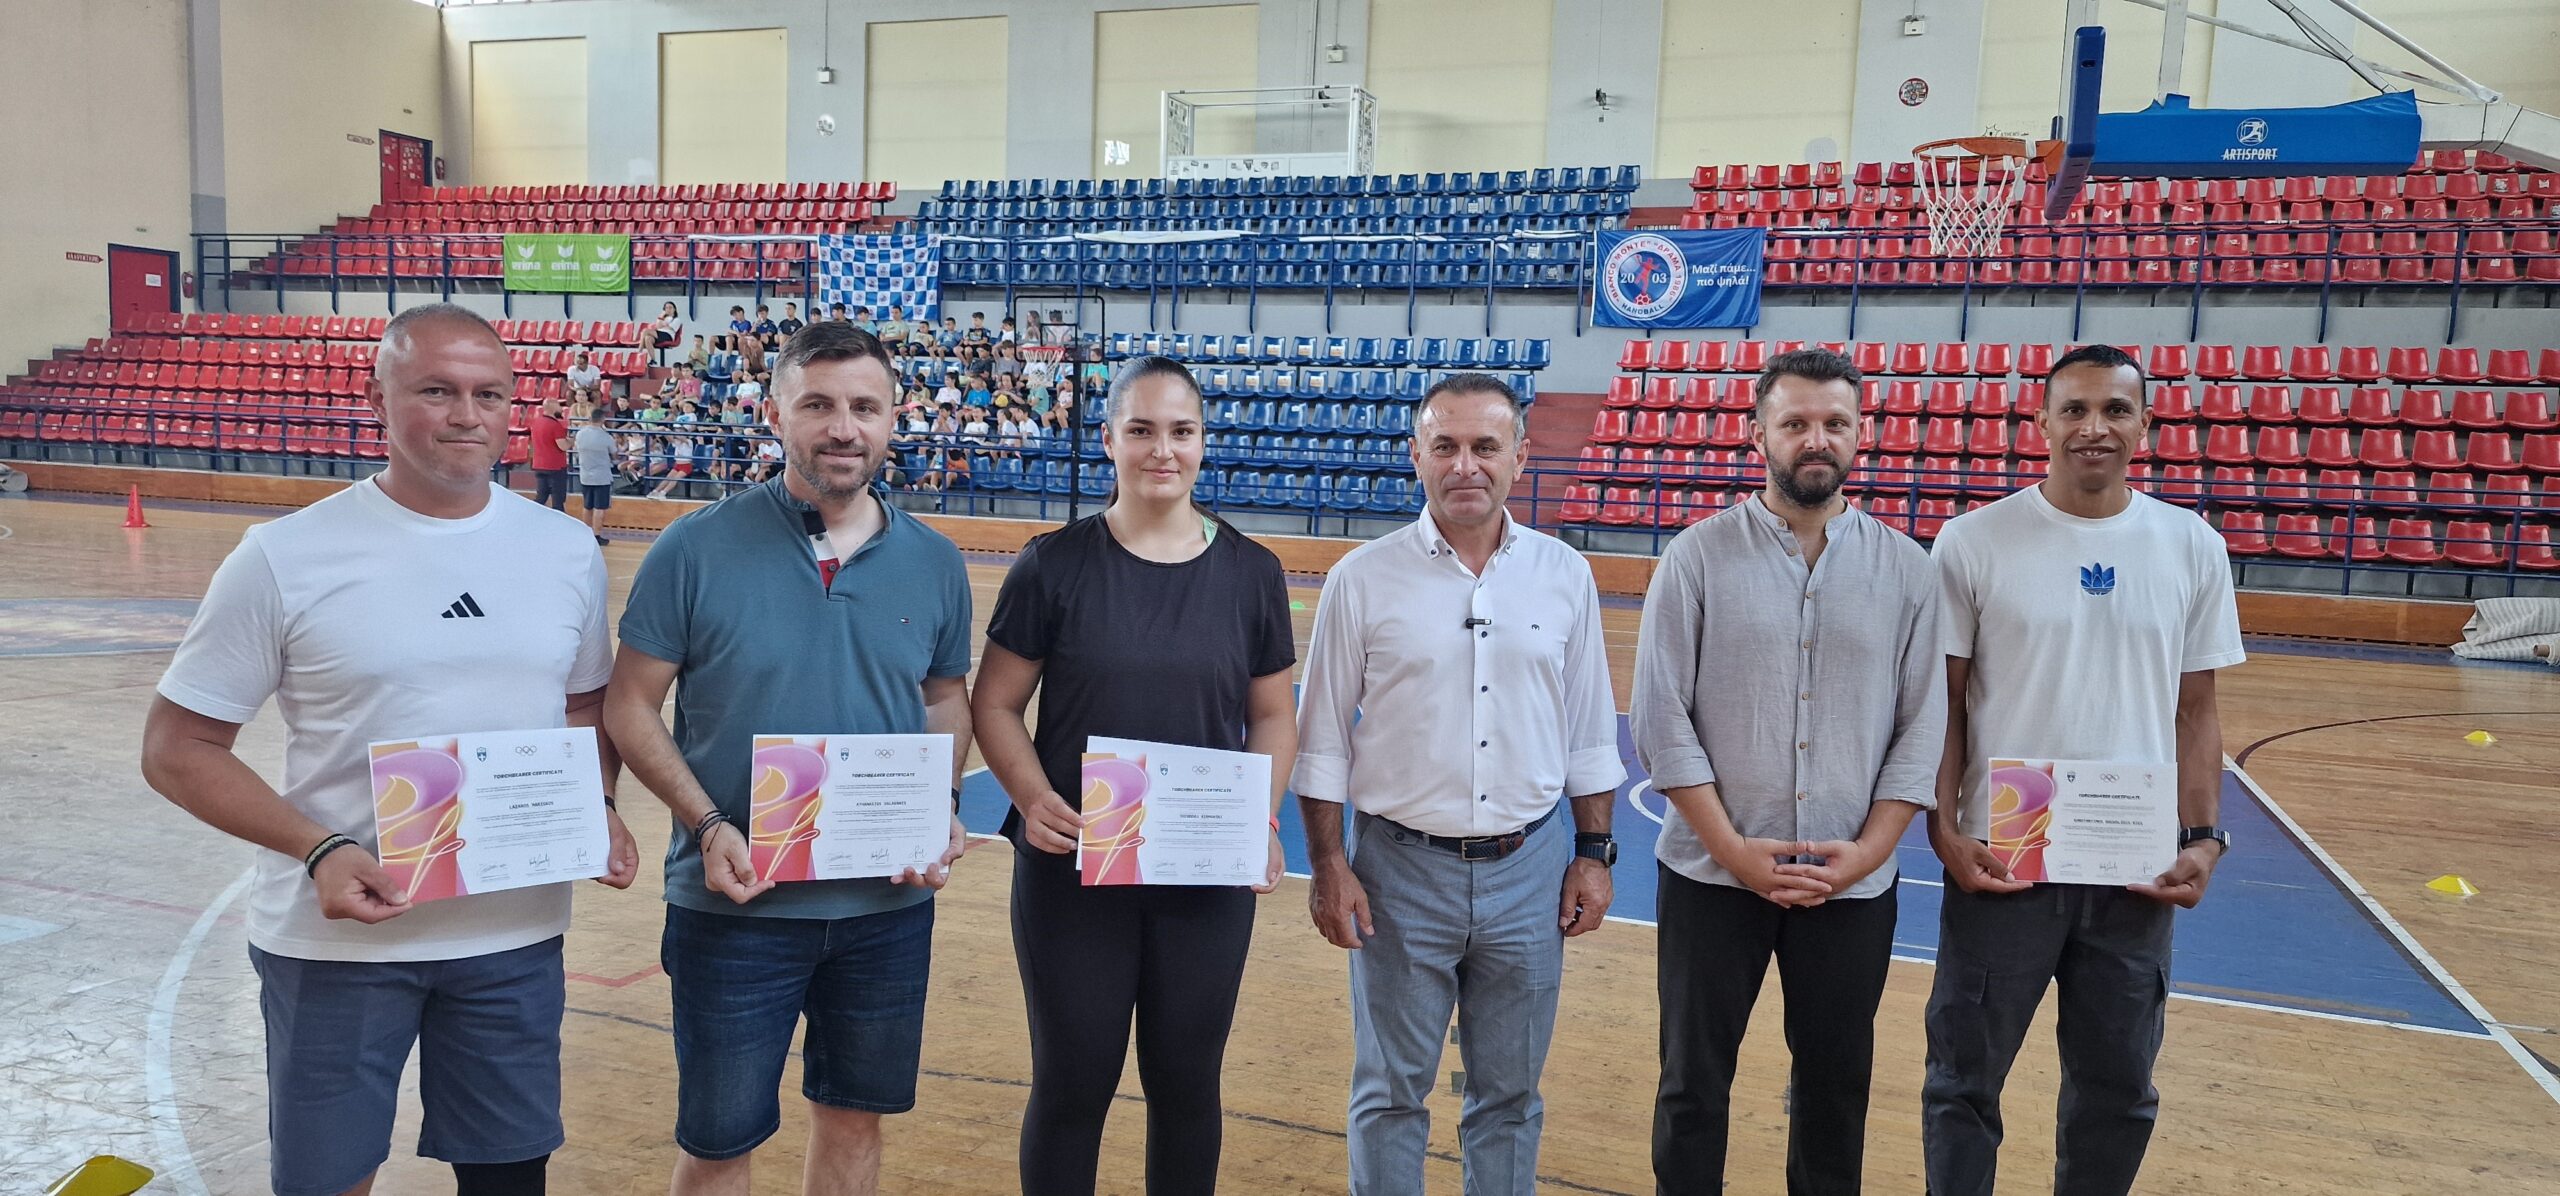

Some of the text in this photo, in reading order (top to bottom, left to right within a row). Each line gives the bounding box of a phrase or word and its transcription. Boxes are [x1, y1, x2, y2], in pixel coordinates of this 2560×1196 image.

[2222, 148, 2278, 161] ARTISPORT
[1692, 263, 1756, 275] Μαζί πάμε...
[1620, 273, 1667, 284] 20 03
[1696, 276, 1750, 288] πιο ψηλά!
[1621, 303, 1665, 315] HANDBALL
[493, 771, 532, 780] TORCHBEARER
